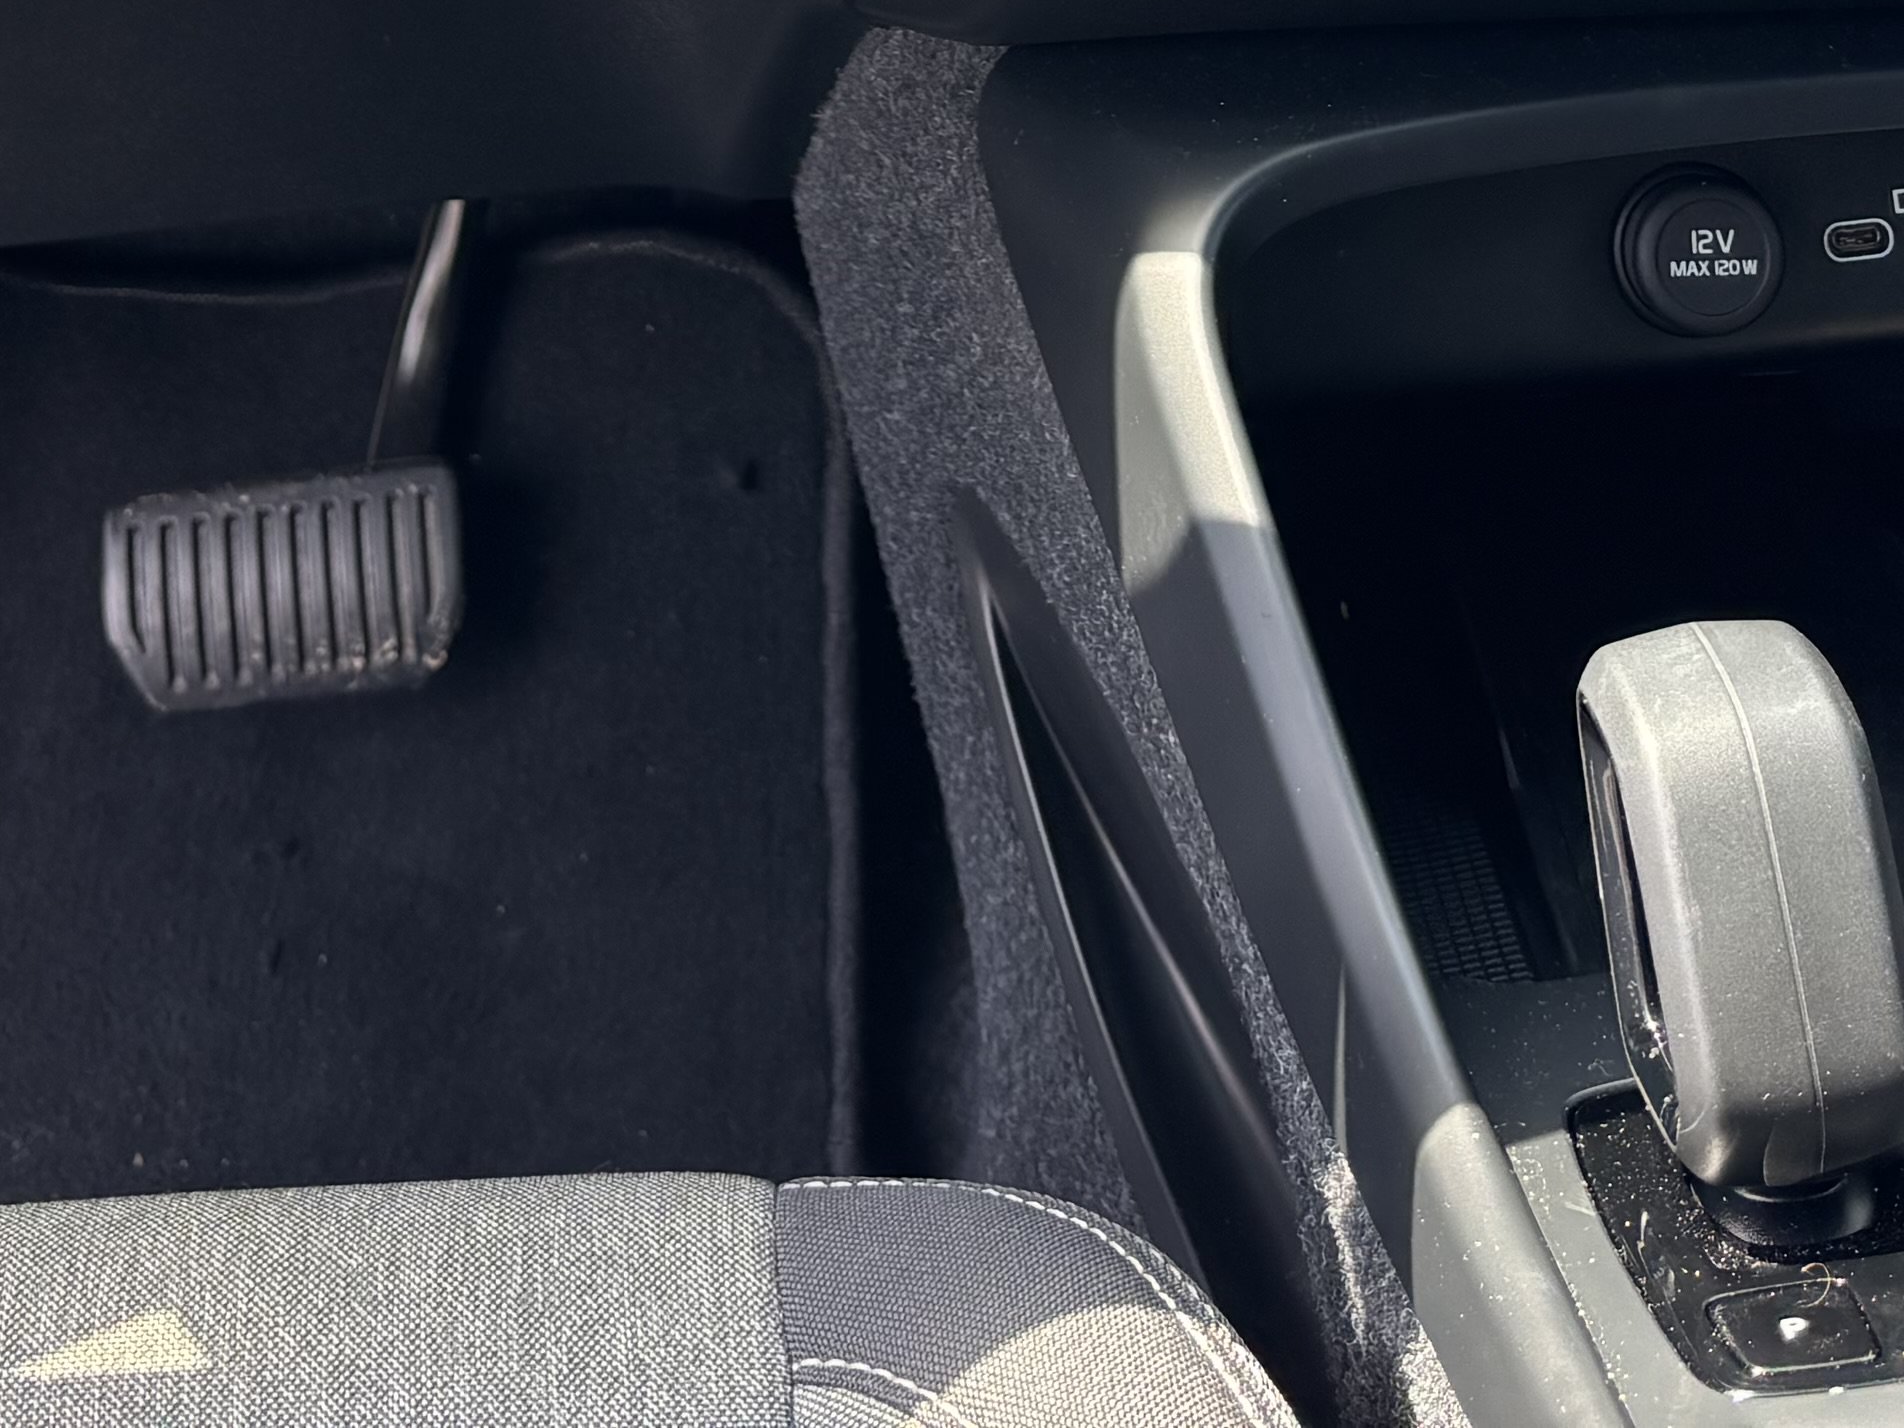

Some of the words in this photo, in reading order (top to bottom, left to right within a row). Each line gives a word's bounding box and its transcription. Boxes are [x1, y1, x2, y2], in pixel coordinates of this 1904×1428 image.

[1691, 229, 1735, 254] 12V
[1670, 260, 1711, 278] MAX
[1779, 1315, 1810, 1342] P
